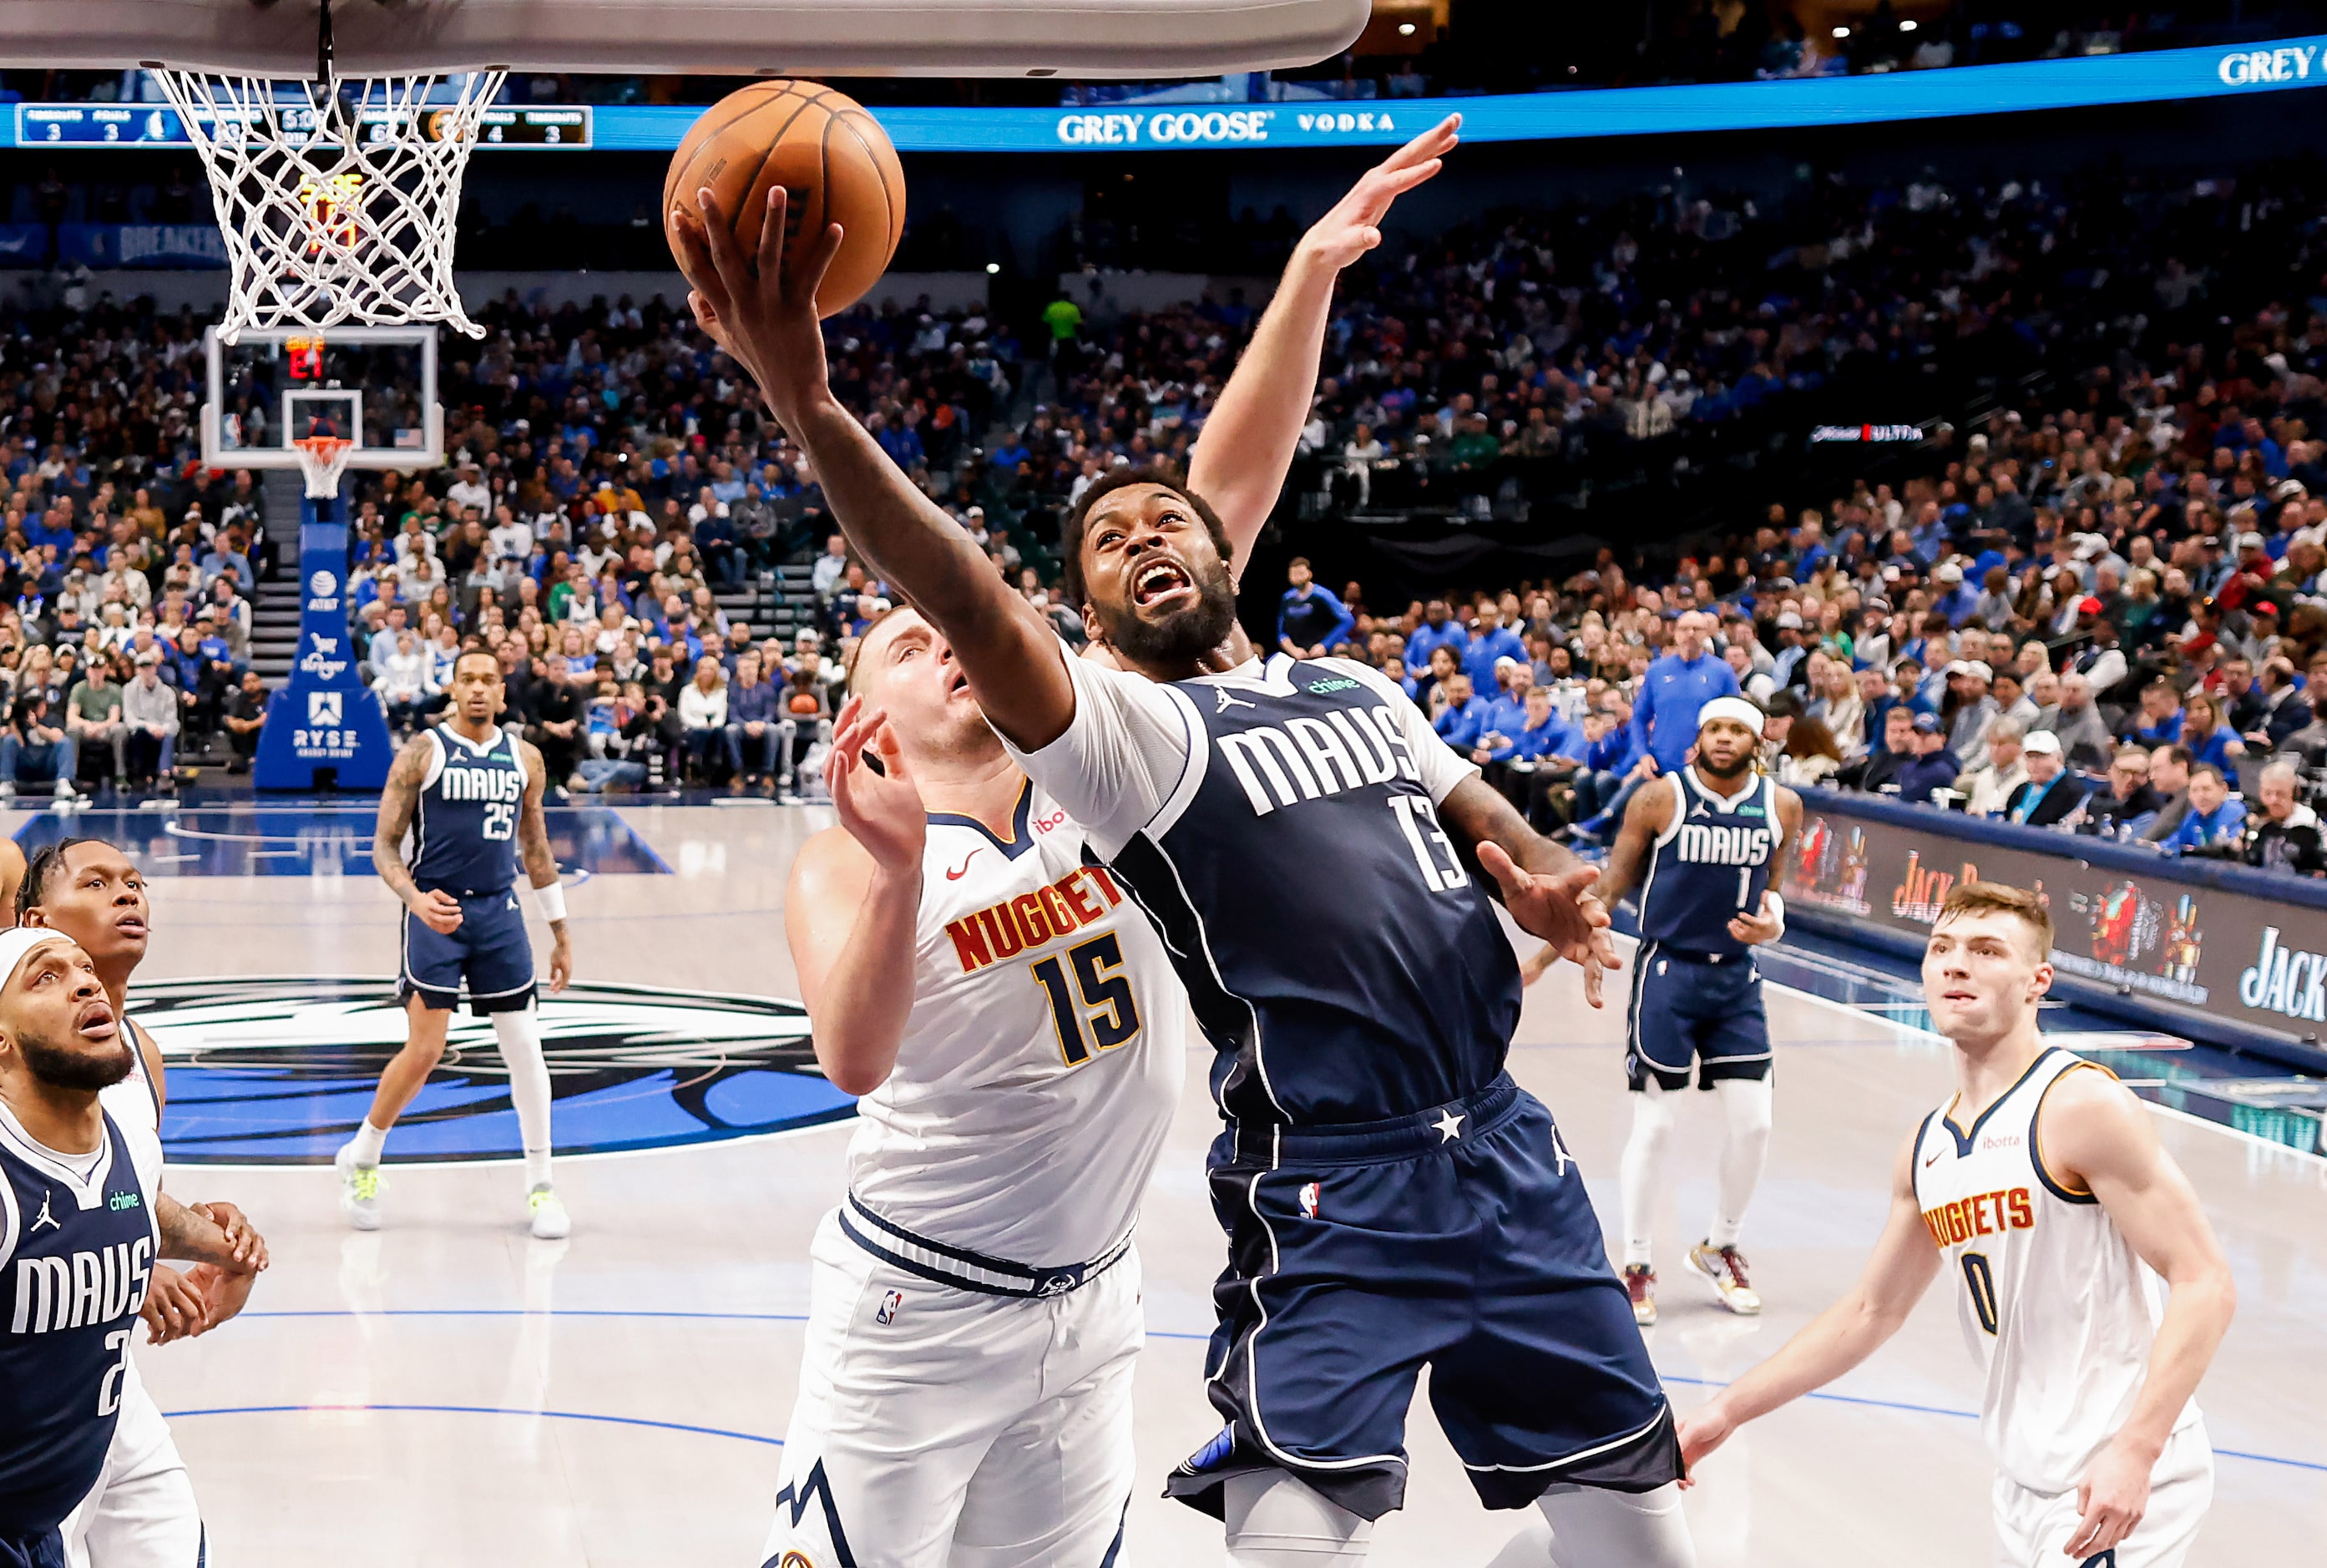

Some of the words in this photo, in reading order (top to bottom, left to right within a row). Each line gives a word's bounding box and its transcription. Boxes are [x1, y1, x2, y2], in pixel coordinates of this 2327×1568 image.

[2218, 45, 2317, 86] GREY
[46, 123, 62, 141] 3
[104, 123, 119, 141] 3
[487, 126, 503, 143] 4
[1057, 114, 1143, 144] GREY
[1297, 114, 1395, 132] VODKA
[1308, 676, 1361, 695] chime
[293, 730, 357, 748] RYSE
[1216, 706, 1421, 817] MAVS
[442, 767, 520, 802] MAVS
[483, 802, 515, 841] 25
[1387, 795, 1468, 893] 13
[1677, 824, 1770, 866] MAVS
[1736, 867, 1752, 901] 1
[2239, 925, 2327, 1022] JACK
[1029, 930, 1142, 1068] 15
[1983, 1136, 2021, 1150] ibotta
[109, 1192, 140, 1211] chime
[11, 1236, 151, 1333] MAVS
[1960, 1252, 1998, 1336] 0
